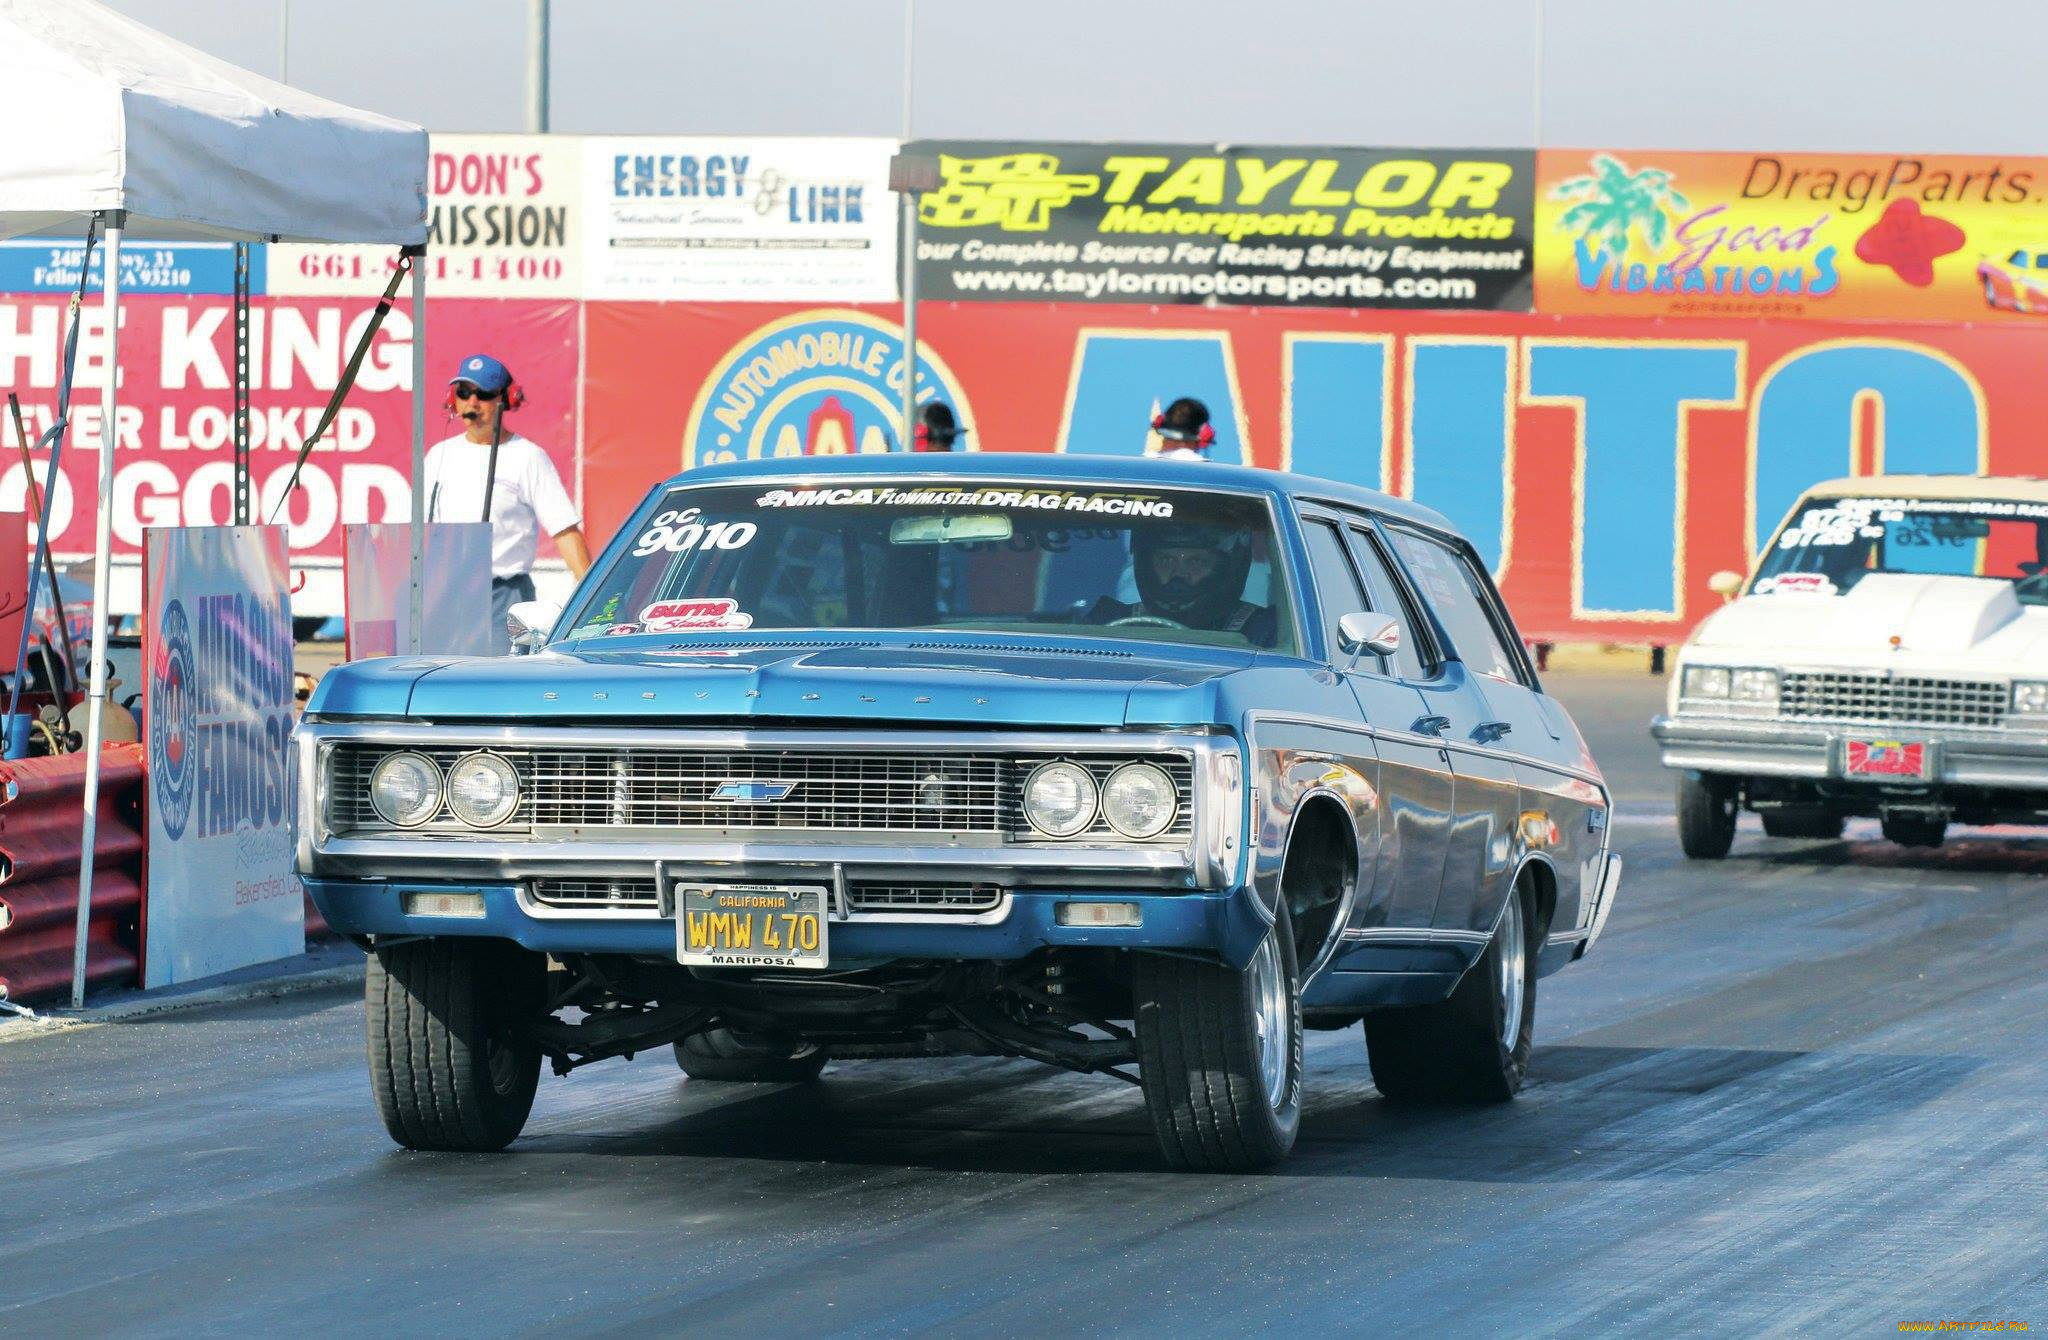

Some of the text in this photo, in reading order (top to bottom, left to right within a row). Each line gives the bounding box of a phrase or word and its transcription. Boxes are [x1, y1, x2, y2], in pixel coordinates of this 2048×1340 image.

[614, 156, 750, 197] ENERGY
[1102, 155, 1513, 210] TAYLOR
[789, 185, 864, 223] LINK
[1099, 205, 1516, 242] Motorsports Products
[1668, 204, 1830, 275] Good
[916, 239, 1526, 273] our Complete Source For Racing Safety Equipment
[952, 267, 1477, 301] www.taylormotorsports.com
[161, 306, 414, 393] KING
[714, 331, 890, 433] AUTOMOBILE
[160, 405, 376, 453] LOOKED
[112, 460, 414, 550] GOOD
[653, 507, 701, 528] OC
[874, 488, 982, 506] FLOWMASTER
[982, 492, 1061, 511] DRAG
[1064, 496, 1174, 518] RACING
[632, 522, 758, 557] 9010
[720, 896, 787, 909] CALIFORNIA
[688, 911, 819, 951] WMW 470
[712, 955, 796, 966] MARIPOSA
